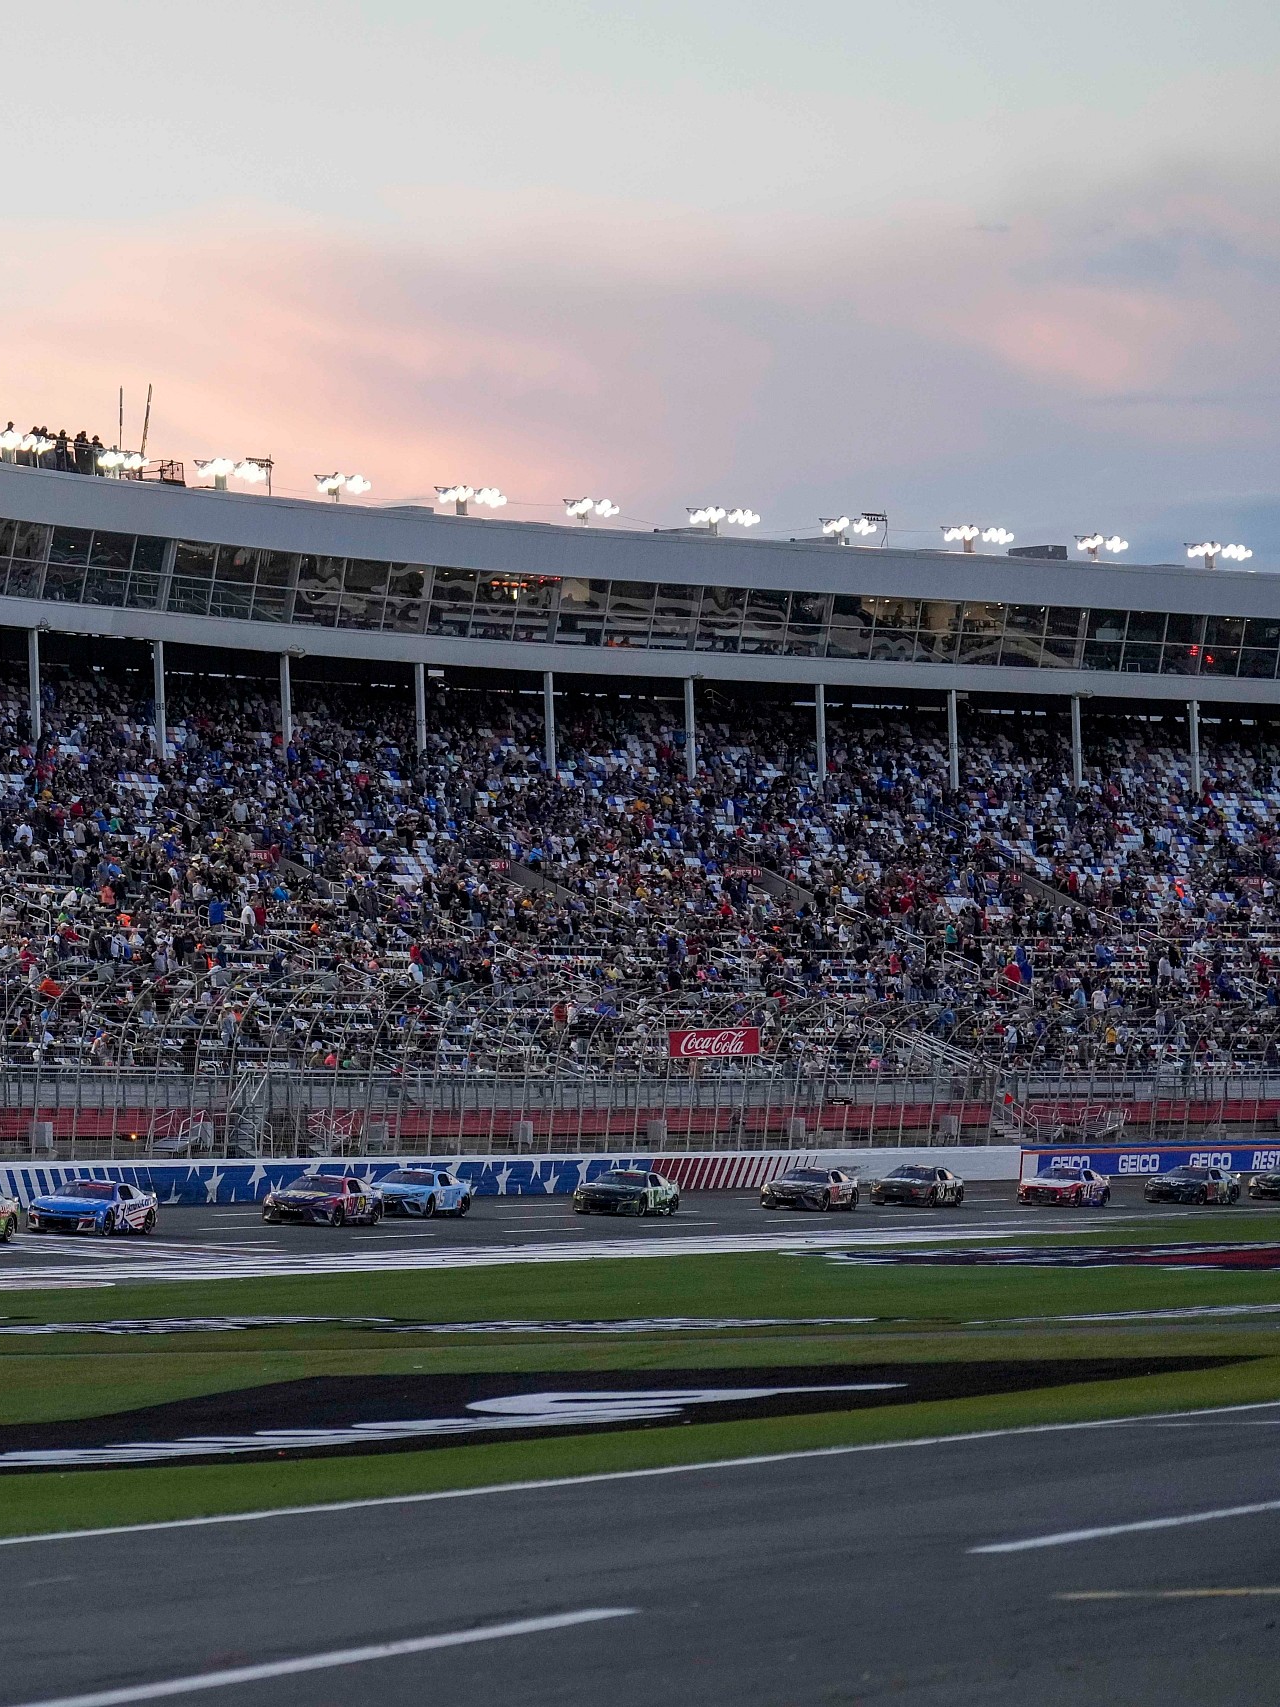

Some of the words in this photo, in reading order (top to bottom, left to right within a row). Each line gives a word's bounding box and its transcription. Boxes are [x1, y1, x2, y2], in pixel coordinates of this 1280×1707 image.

[680, 1031, 747, 1055] Coca-Cola
[1051, 1155, 1091, 1169] GEICO
[1118, 1154, 1160, 1173] GEICO
[1189, 1152, 1232, 1171] GEICO
